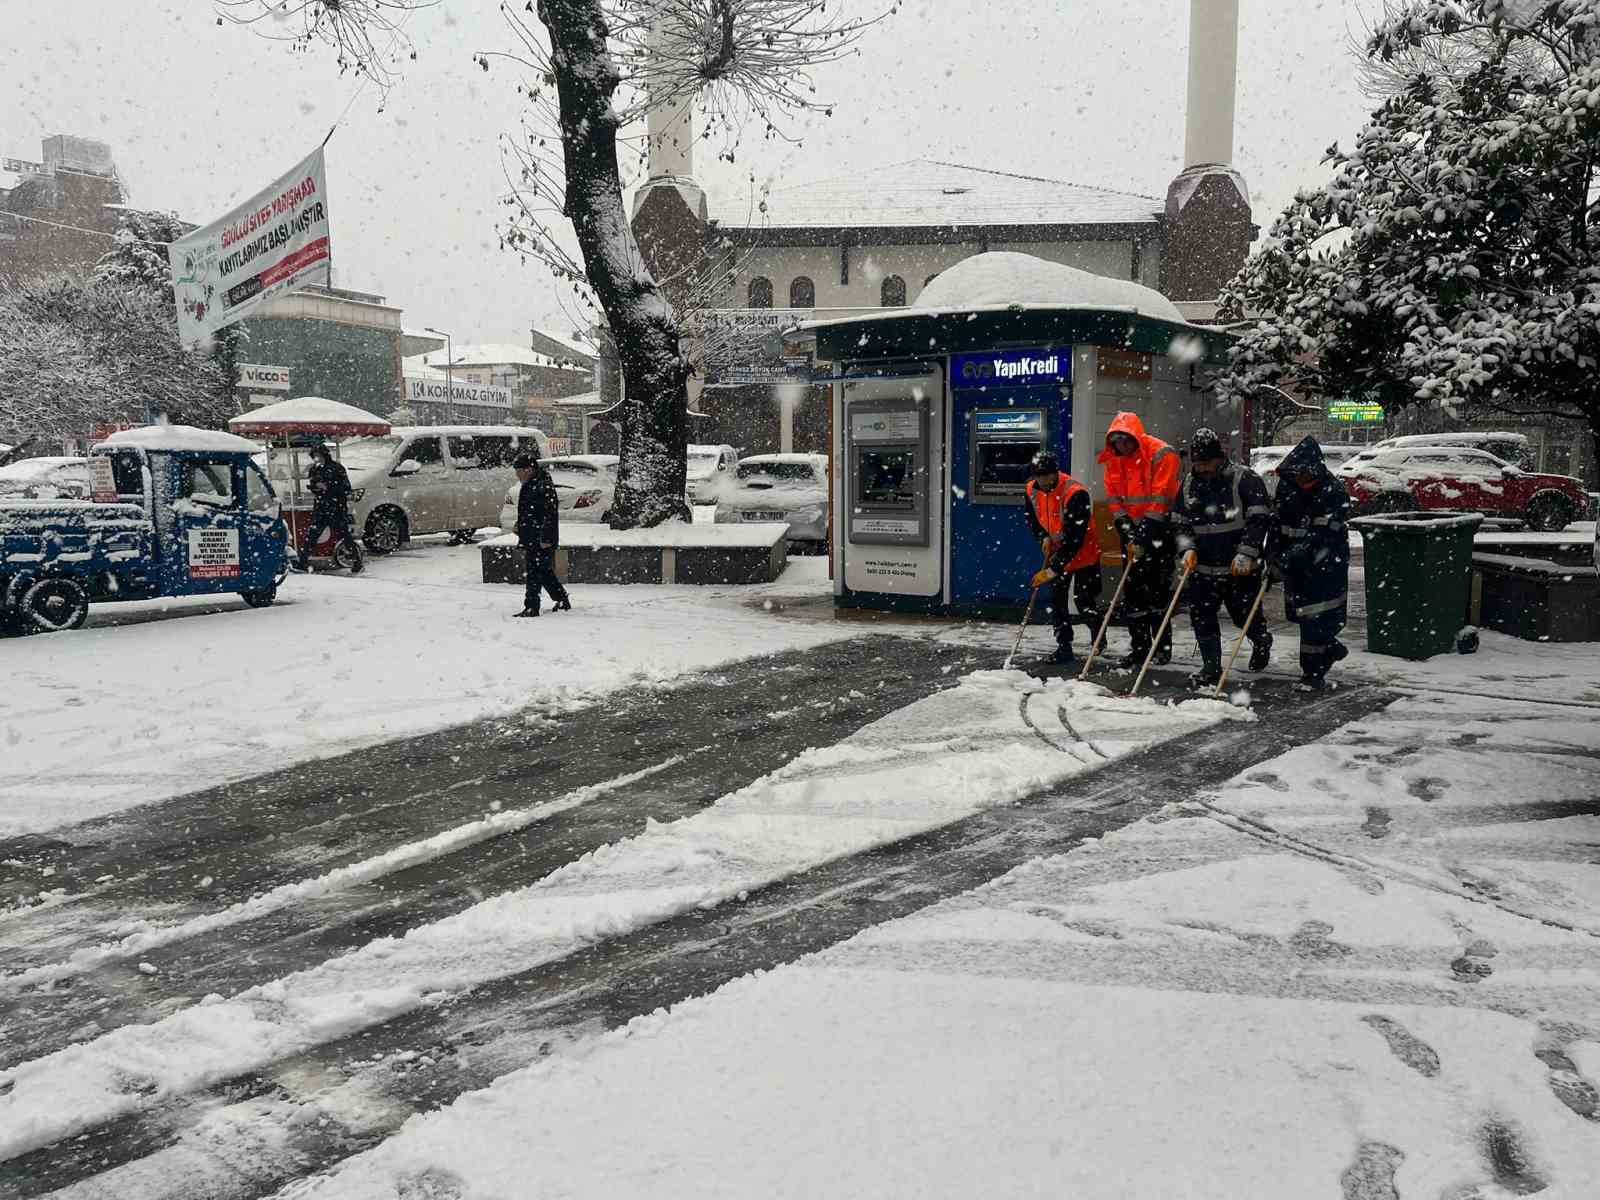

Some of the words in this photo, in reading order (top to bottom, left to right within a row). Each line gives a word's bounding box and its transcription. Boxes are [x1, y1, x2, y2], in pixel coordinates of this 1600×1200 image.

[993, 356, 1058, 379] YapıKredi
[427, 385, 478, 401] KORKMAZ
[480, 386, 507, 403] GİYİM
